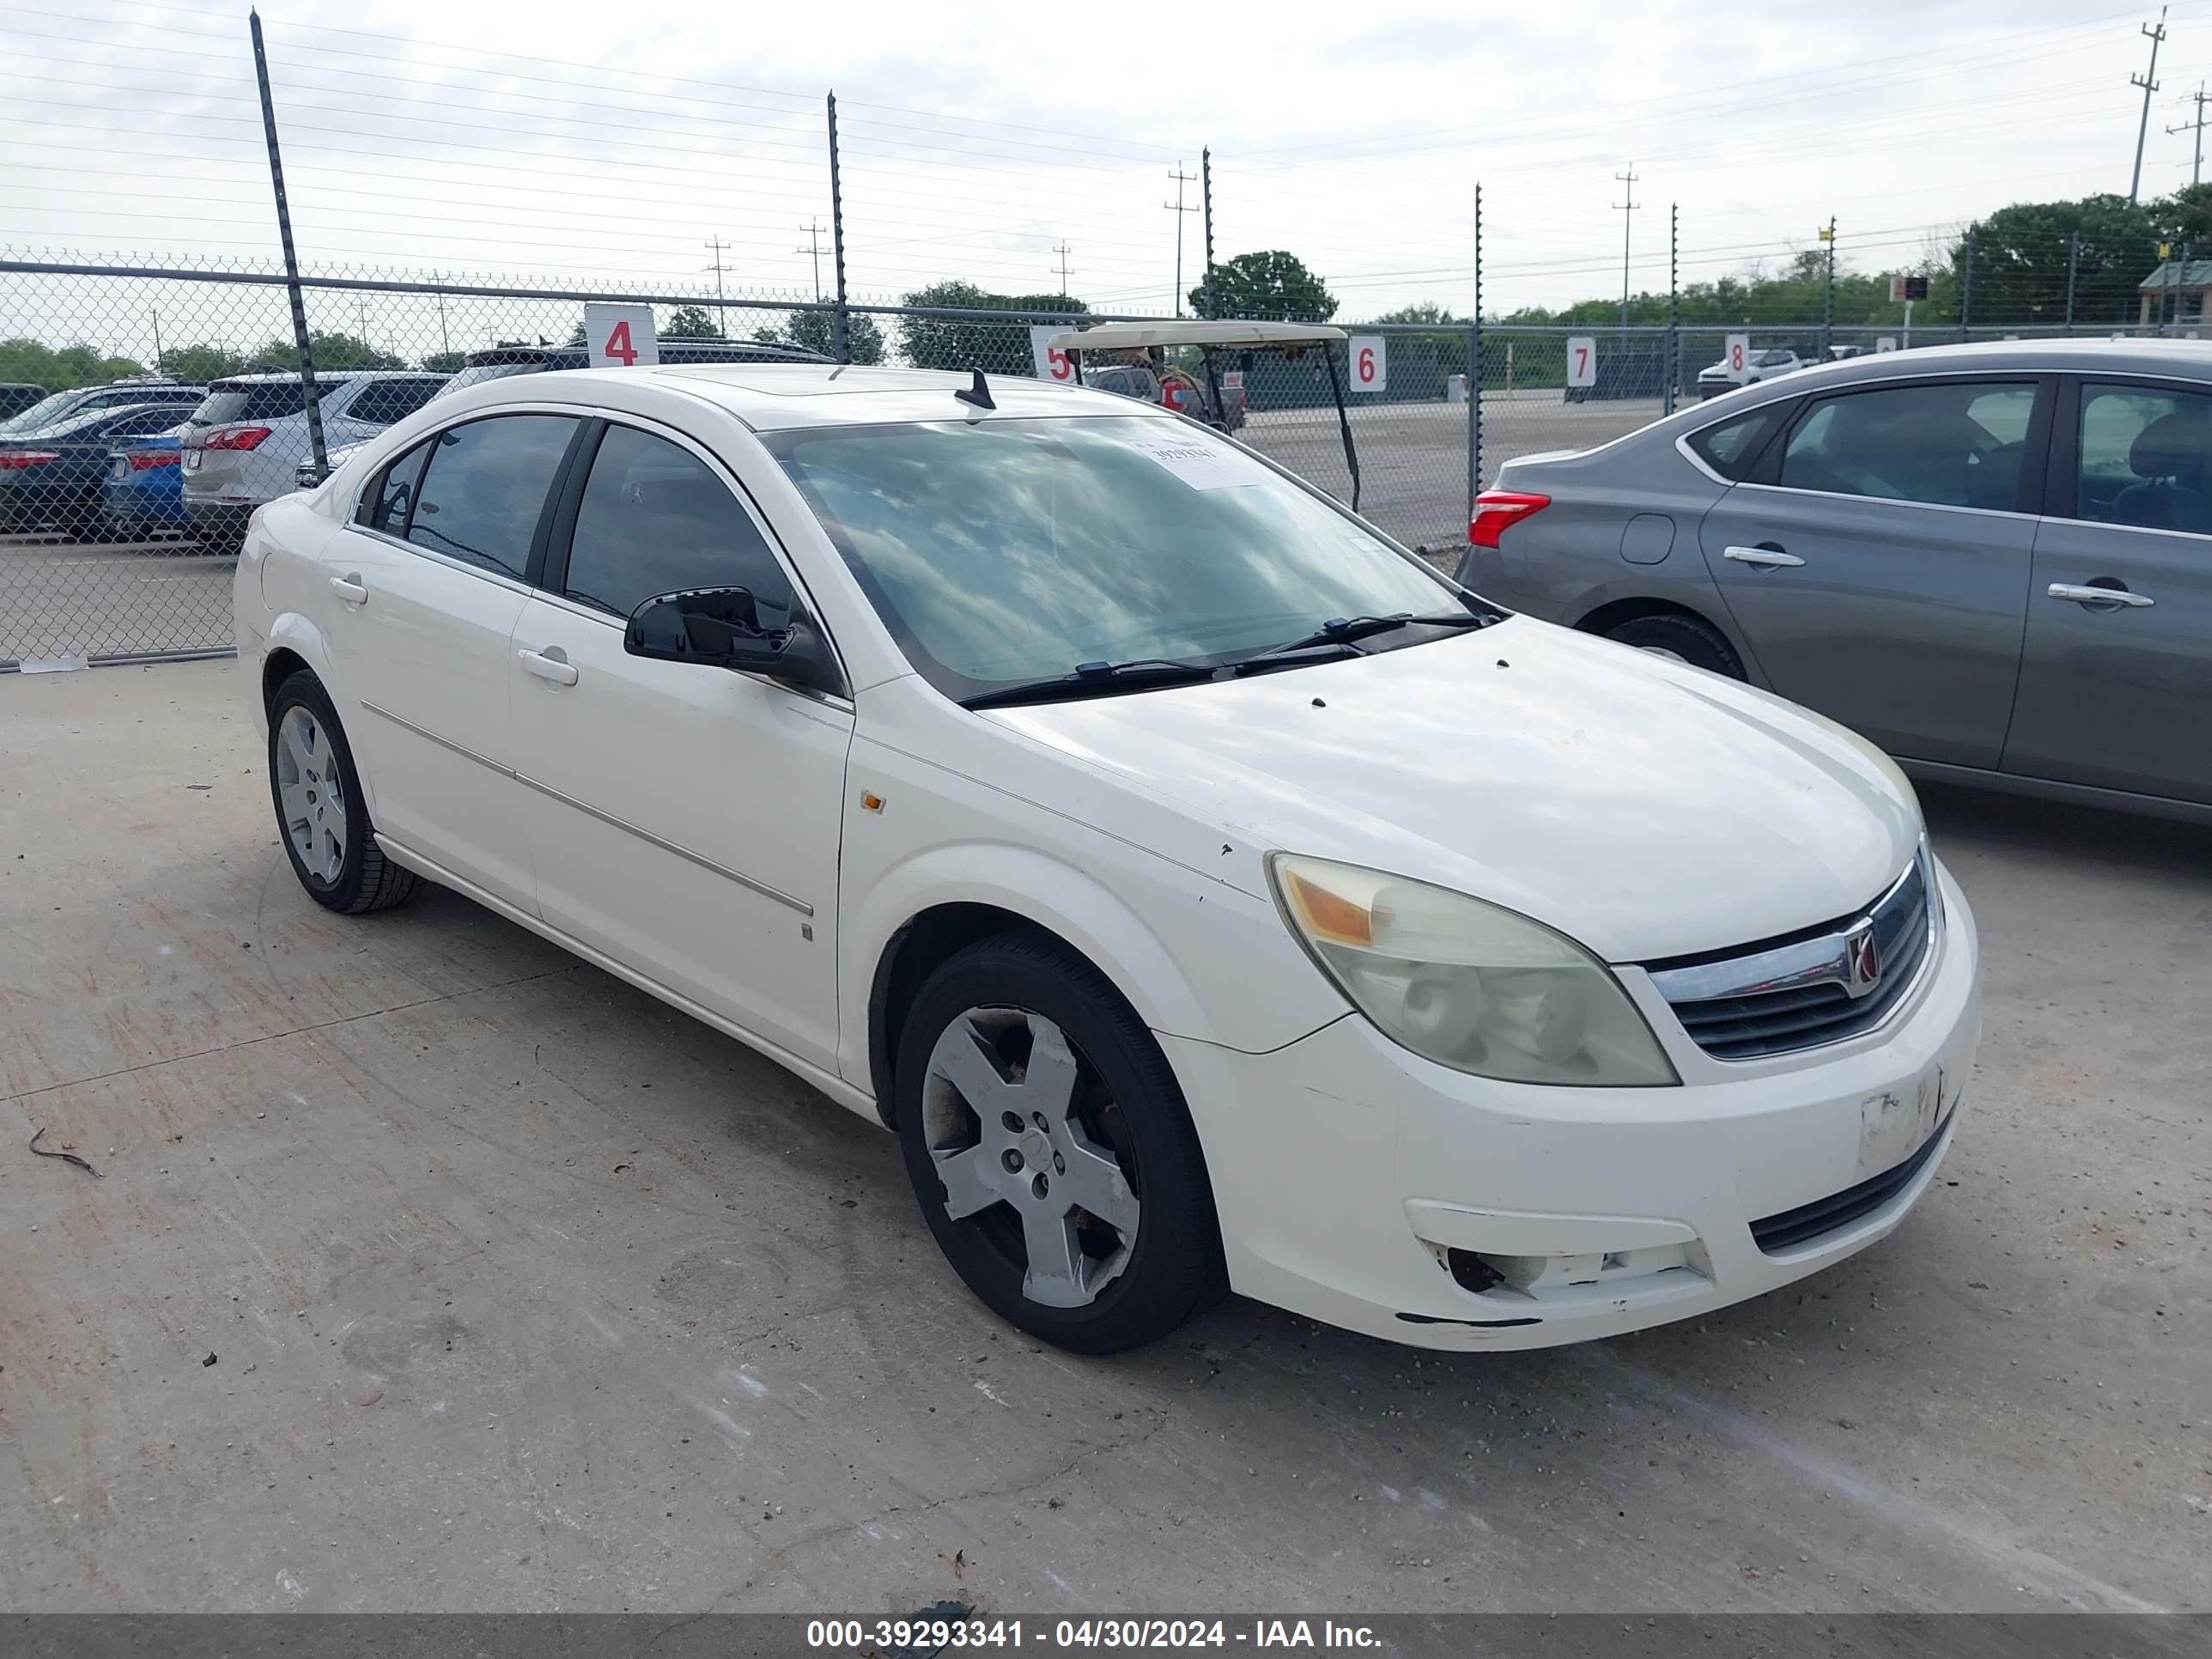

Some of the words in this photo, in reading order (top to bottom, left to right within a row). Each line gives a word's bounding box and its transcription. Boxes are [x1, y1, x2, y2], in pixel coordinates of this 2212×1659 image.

[605, 321, 638, 366] 4
[1733, 344, 1742, 371] 8
[1048, 348, 1070, 380] 5
[1359, 349, 1374, 383] 6
[1576, 349, 1588, 379] 7
